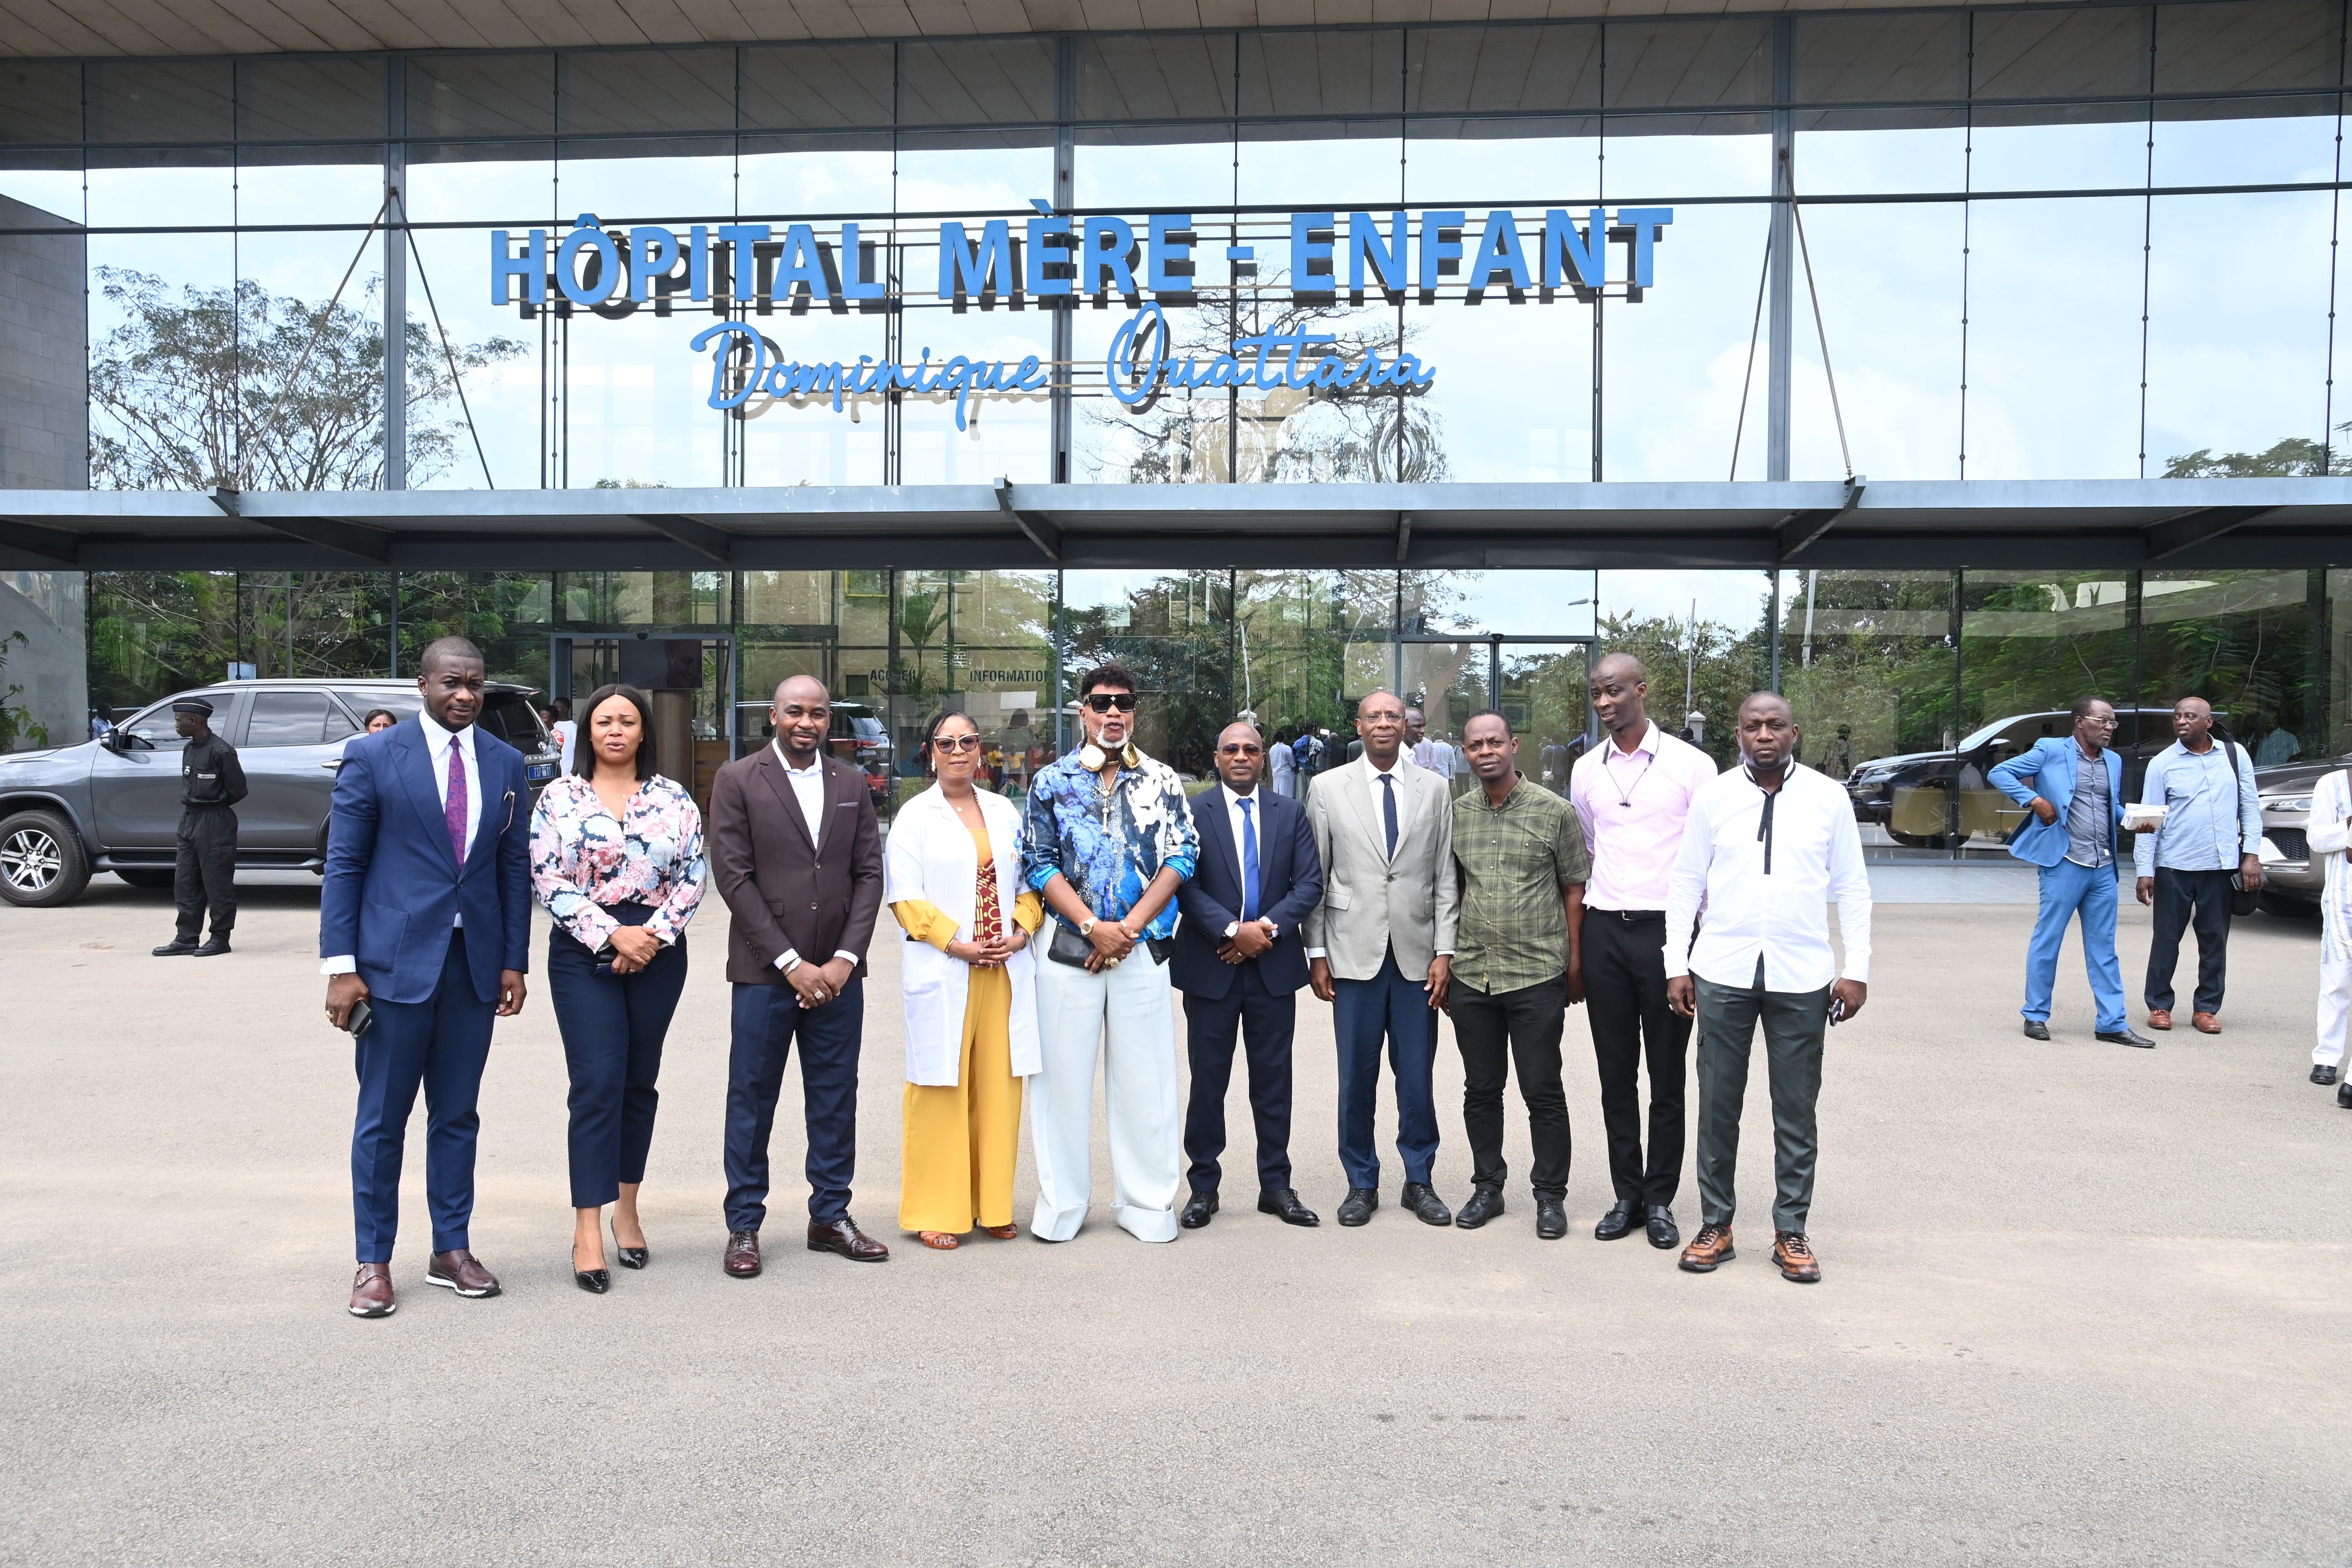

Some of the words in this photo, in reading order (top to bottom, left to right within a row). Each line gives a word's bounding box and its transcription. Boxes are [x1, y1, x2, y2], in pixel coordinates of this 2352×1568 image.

[492, 214, 884, 305] HÔPITAL
[939, 199, 1192, 299] MÈRE
[1291, 208, 1673, 291] ENFANT
[691, 321, 1046, 430] Dominique
[1107, 301, 1435, 403] Ouattara
